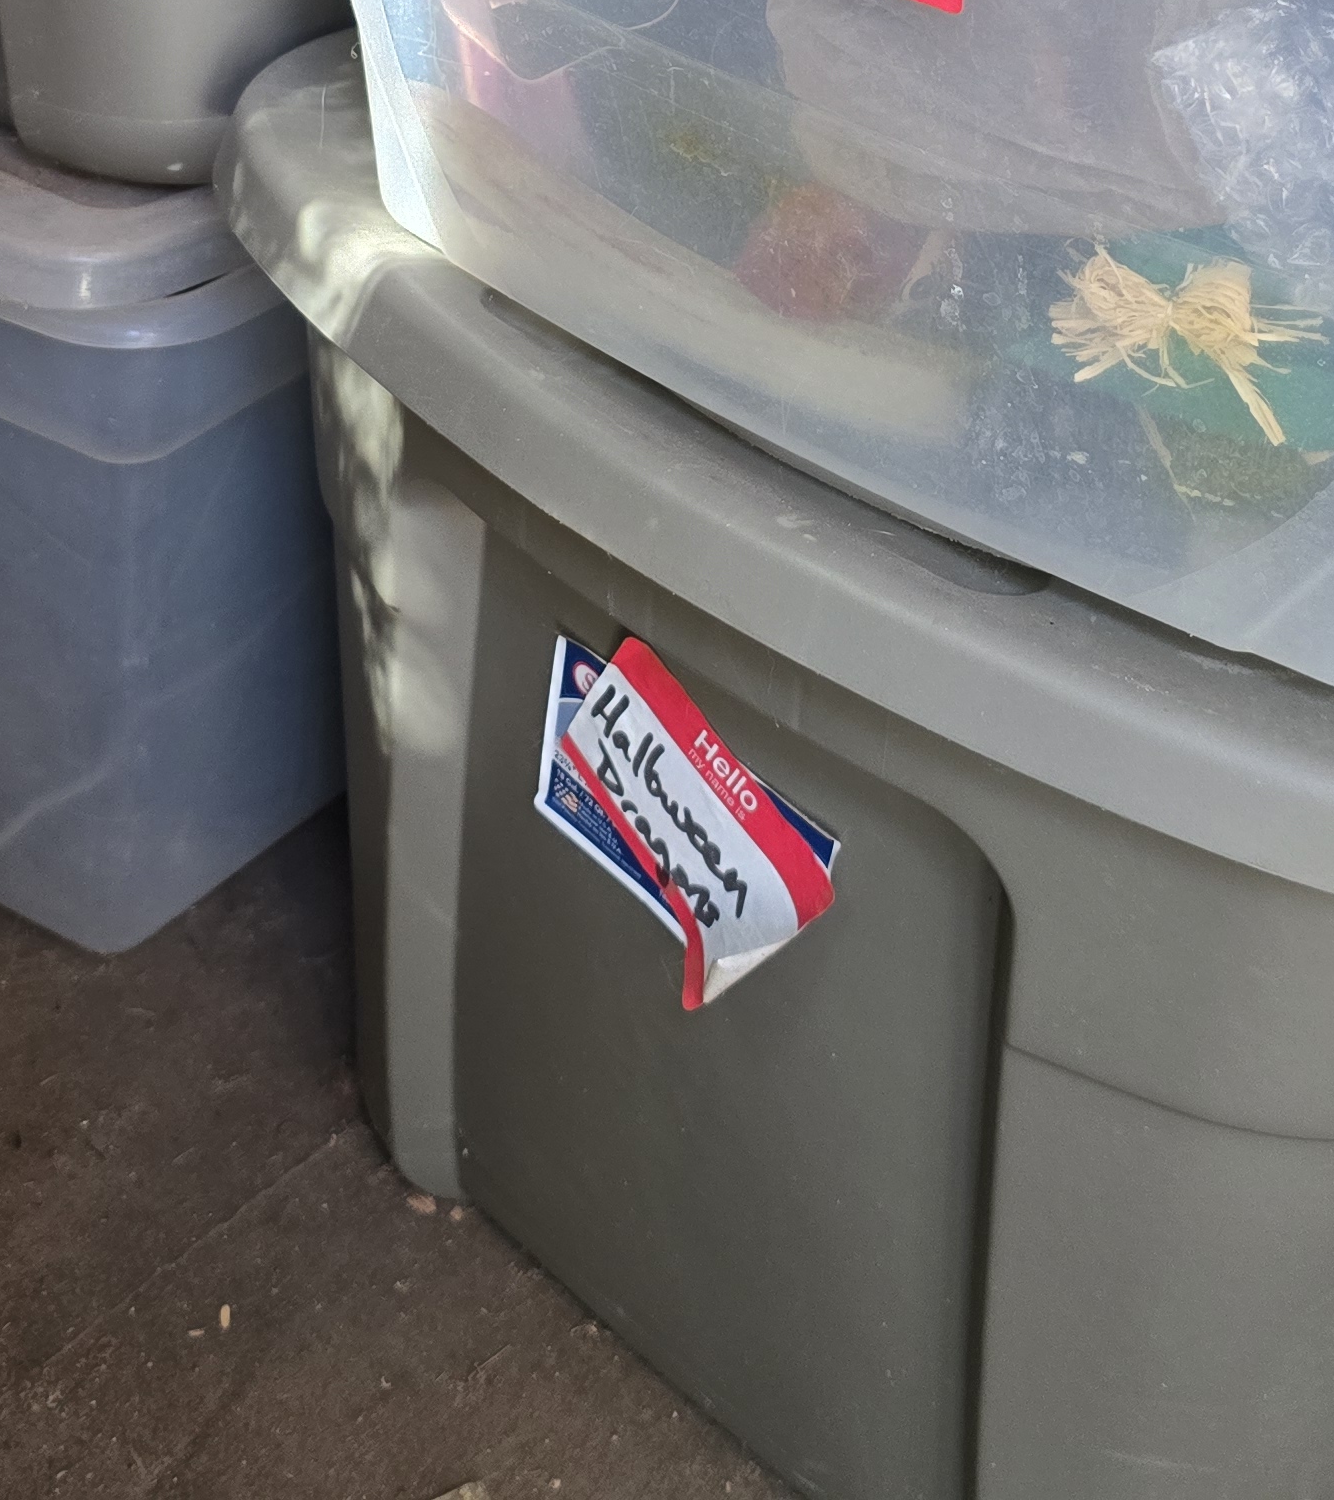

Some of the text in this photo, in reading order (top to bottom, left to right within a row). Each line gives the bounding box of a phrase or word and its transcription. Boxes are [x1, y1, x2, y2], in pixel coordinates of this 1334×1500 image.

[591, 684, 747, 919] Halloween
[688, 748, 746, 820] my name is
[694, 729, 758, 811] Hello
